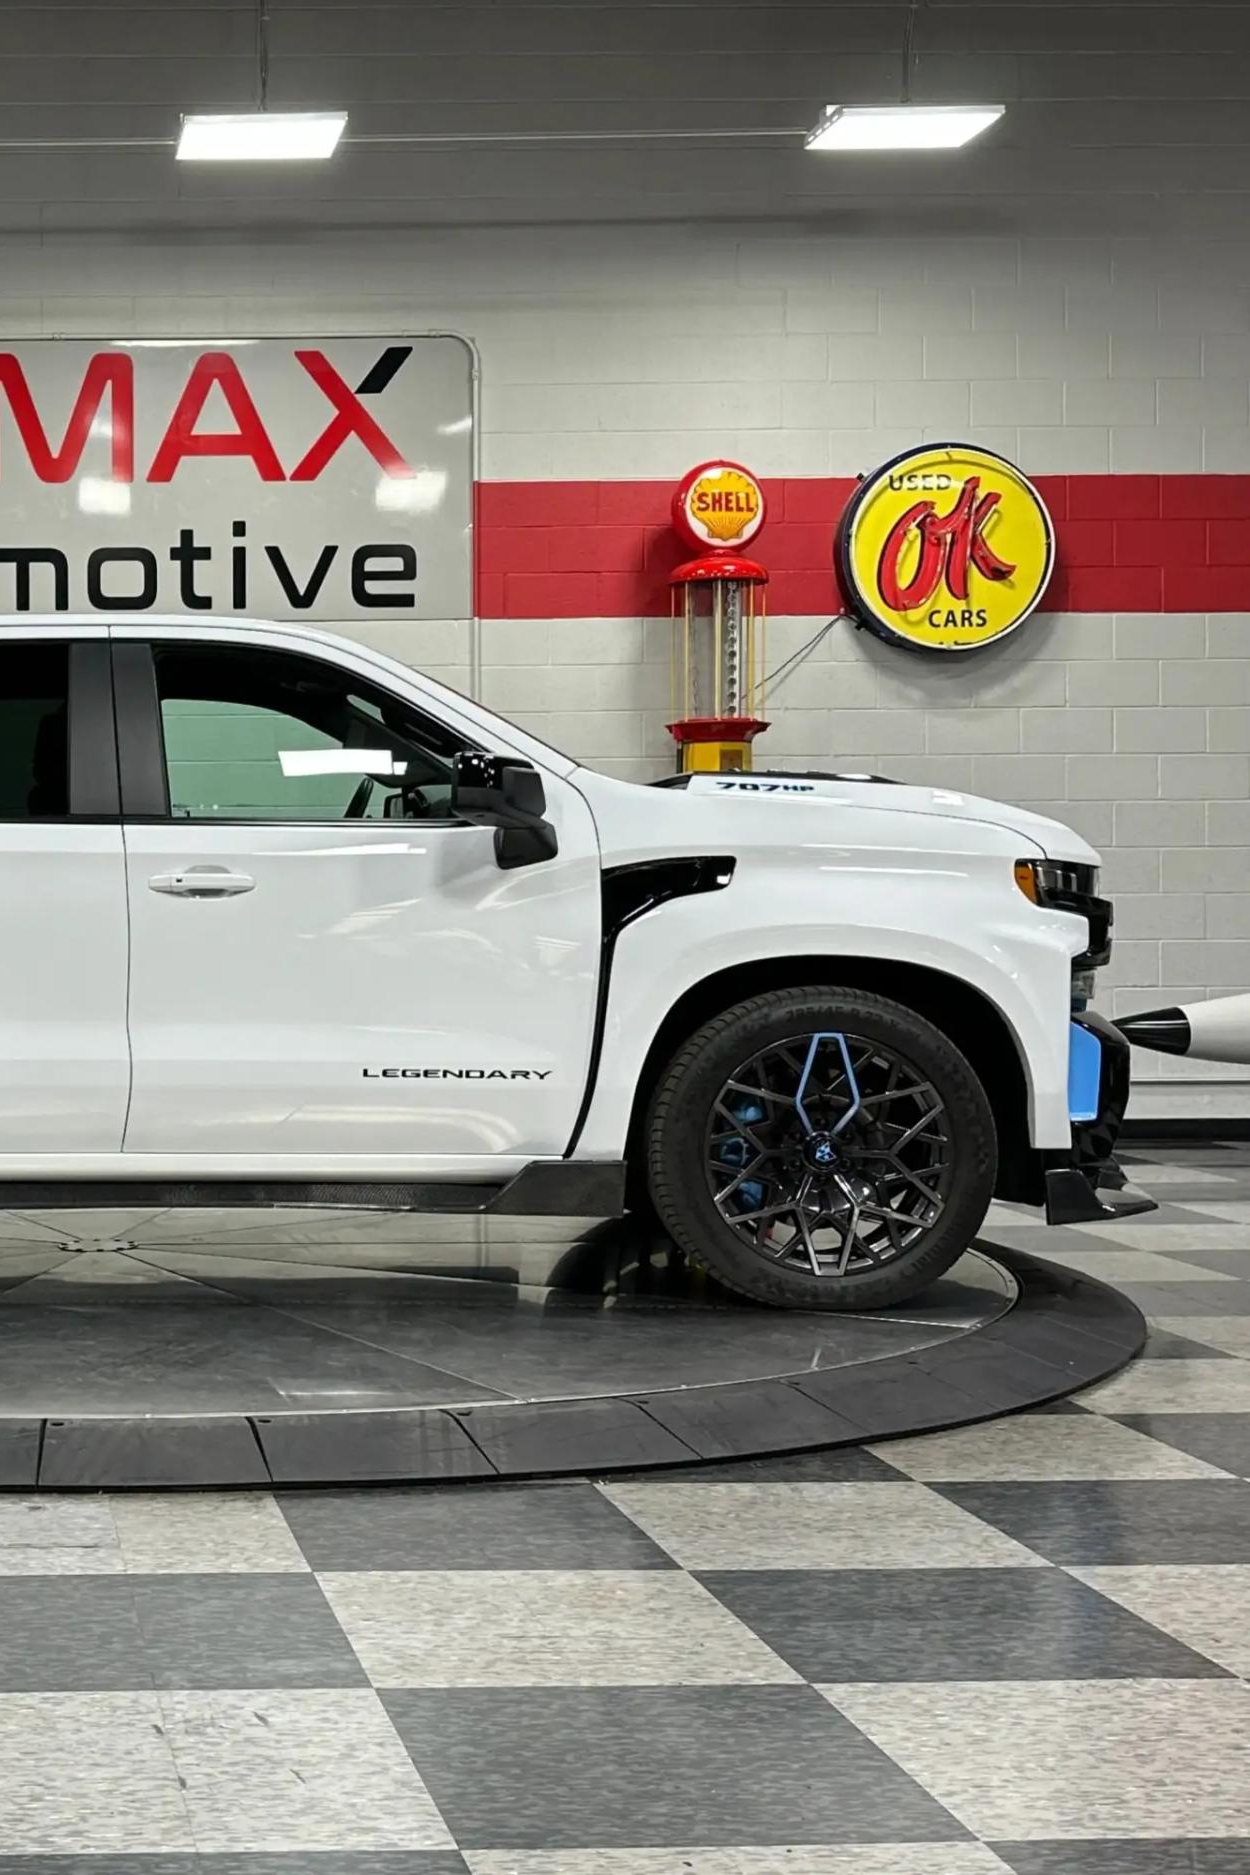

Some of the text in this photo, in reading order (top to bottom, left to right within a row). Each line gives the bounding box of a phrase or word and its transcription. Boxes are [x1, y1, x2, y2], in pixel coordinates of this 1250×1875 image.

[888, 474, 952, 491] USED
[696, 491, 755, 513] SHELL
[876, 476, 1017, 612] OK
[928, 609, 988, 628] CARS
[716, 781, 815, 792] 707HP
[362, 1068, 552, 1080] LEGENDARY
